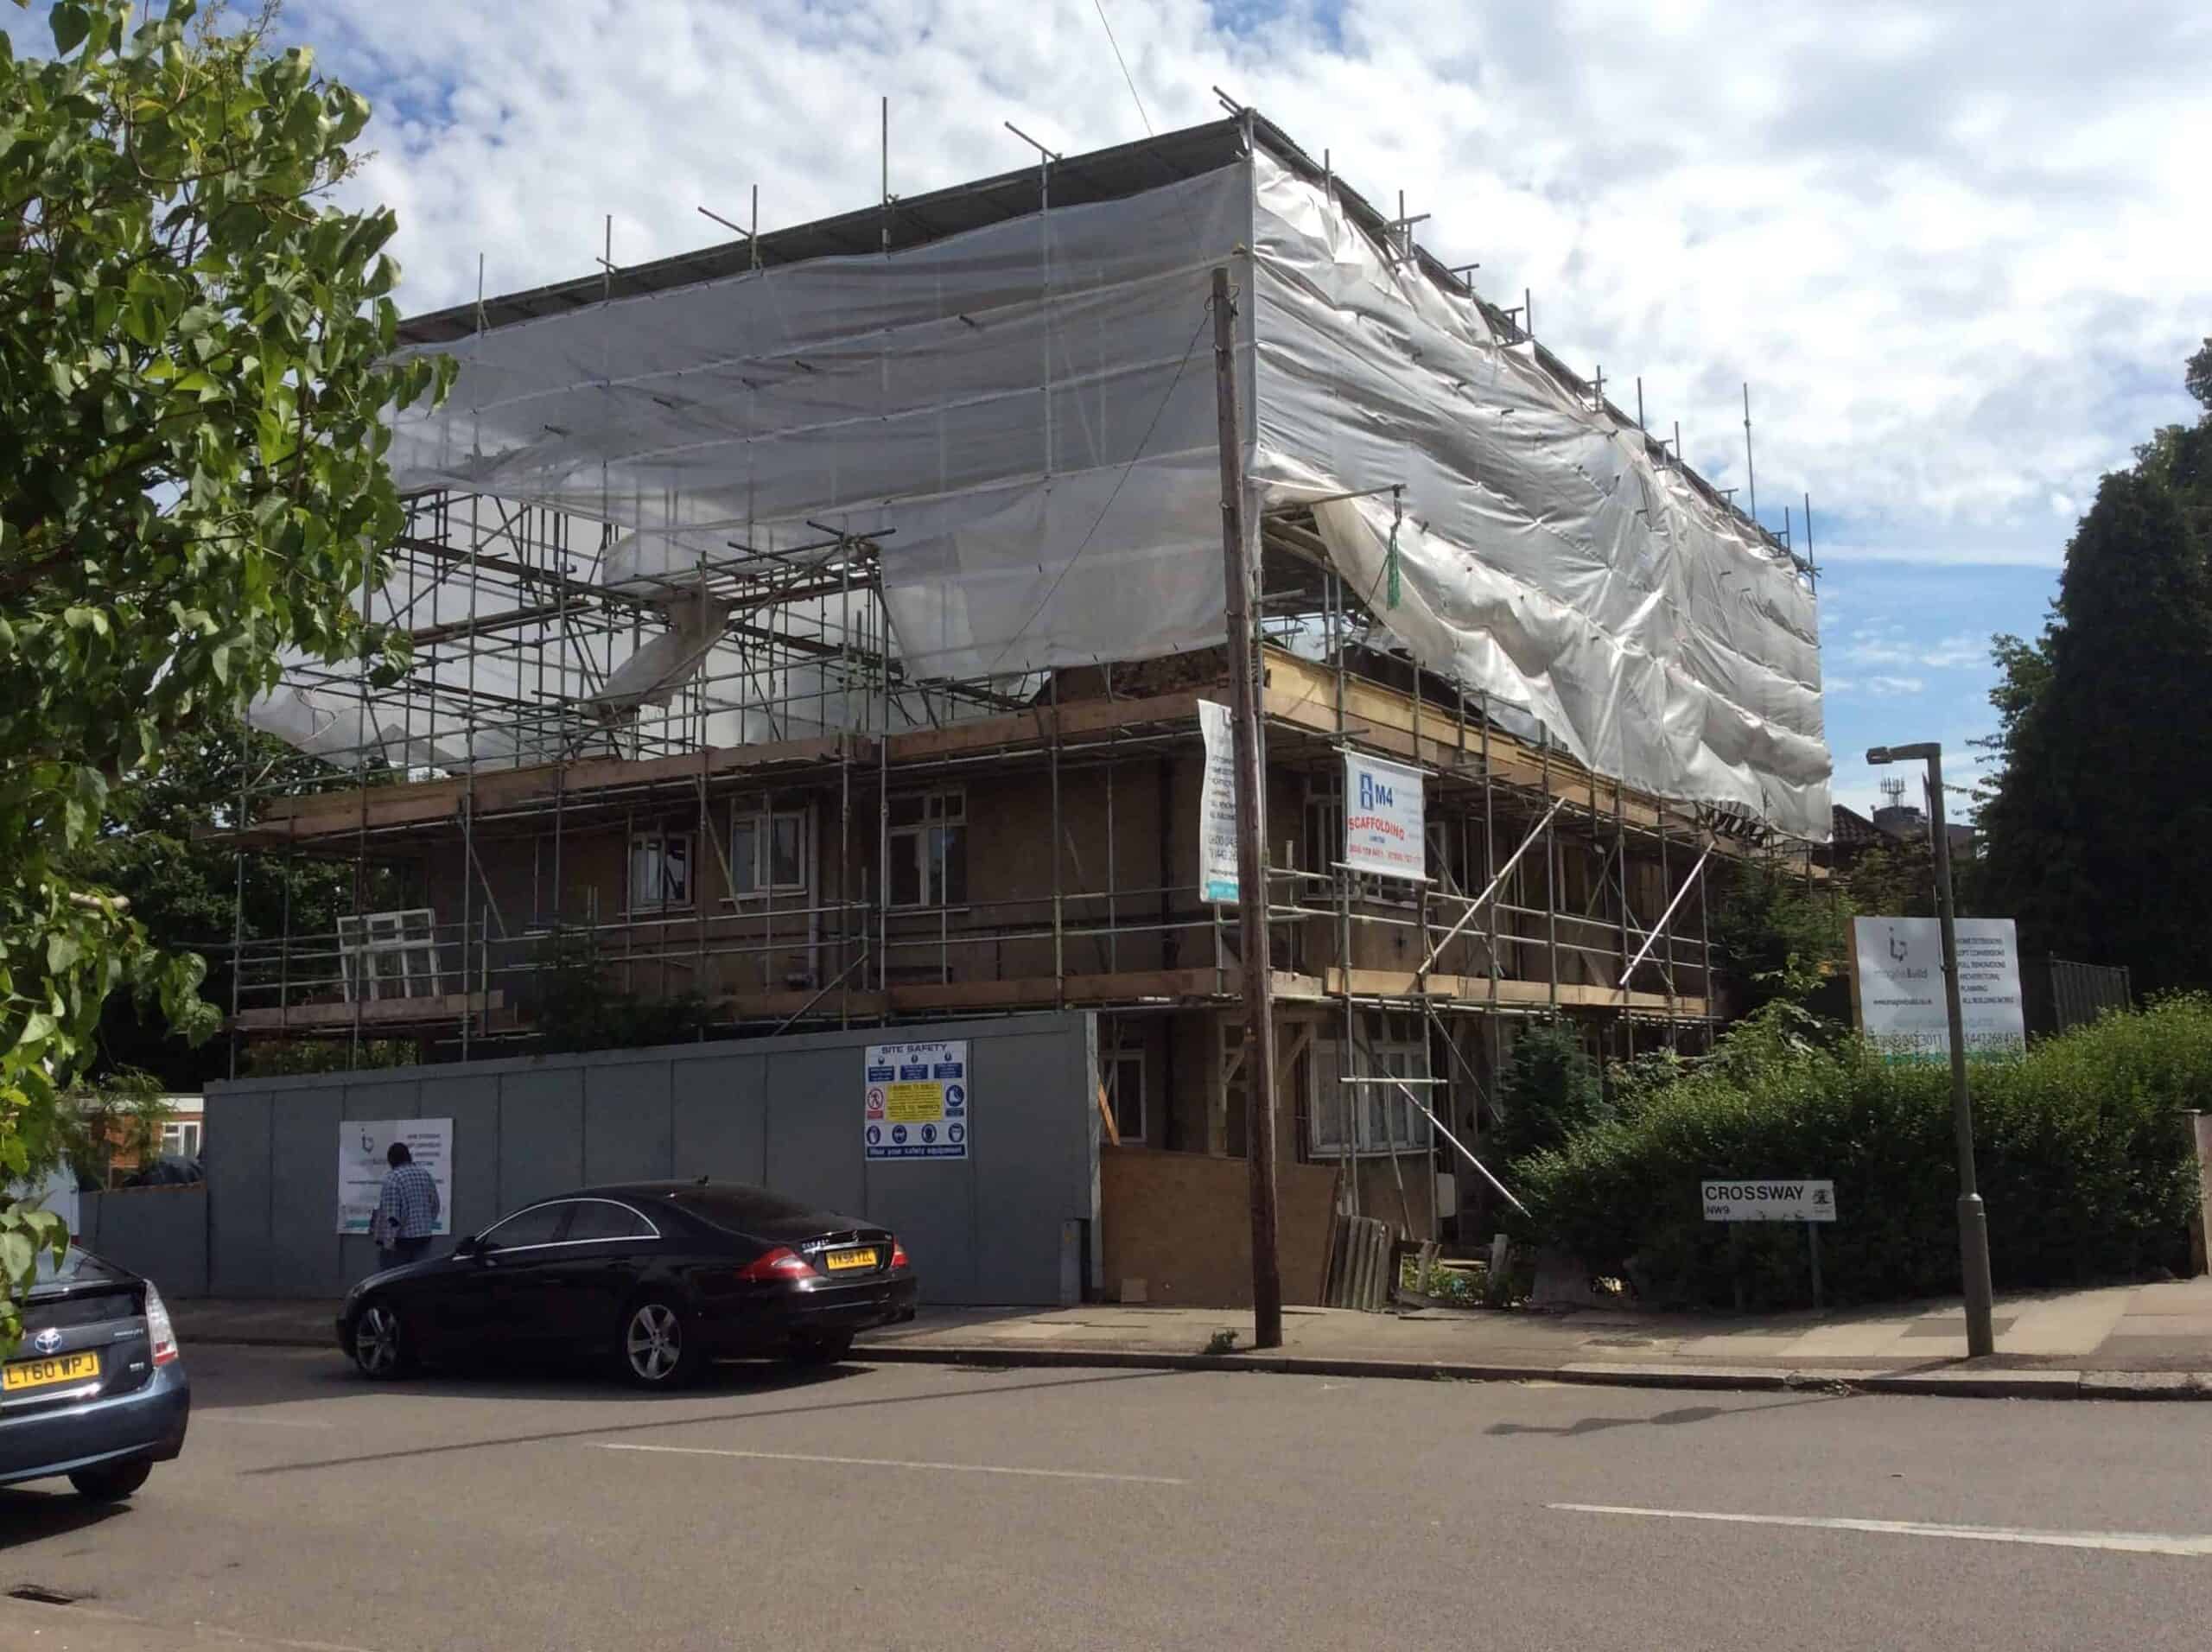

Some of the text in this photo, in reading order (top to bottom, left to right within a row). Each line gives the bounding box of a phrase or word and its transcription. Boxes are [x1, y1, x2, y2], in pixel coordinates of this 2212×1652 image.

[1375, 784, 1393, 807] M4
[1348, 816, 1405, 841] SCAFFOLDING
[881, 1044, 948, 1054] SITE SAFETY
[1705, 1185, 1804, 1200] CROSSWAY
[1707, 1204, 1731, 1215] NW9
[6, 1354, 95, 1384] LT60 WPJ
